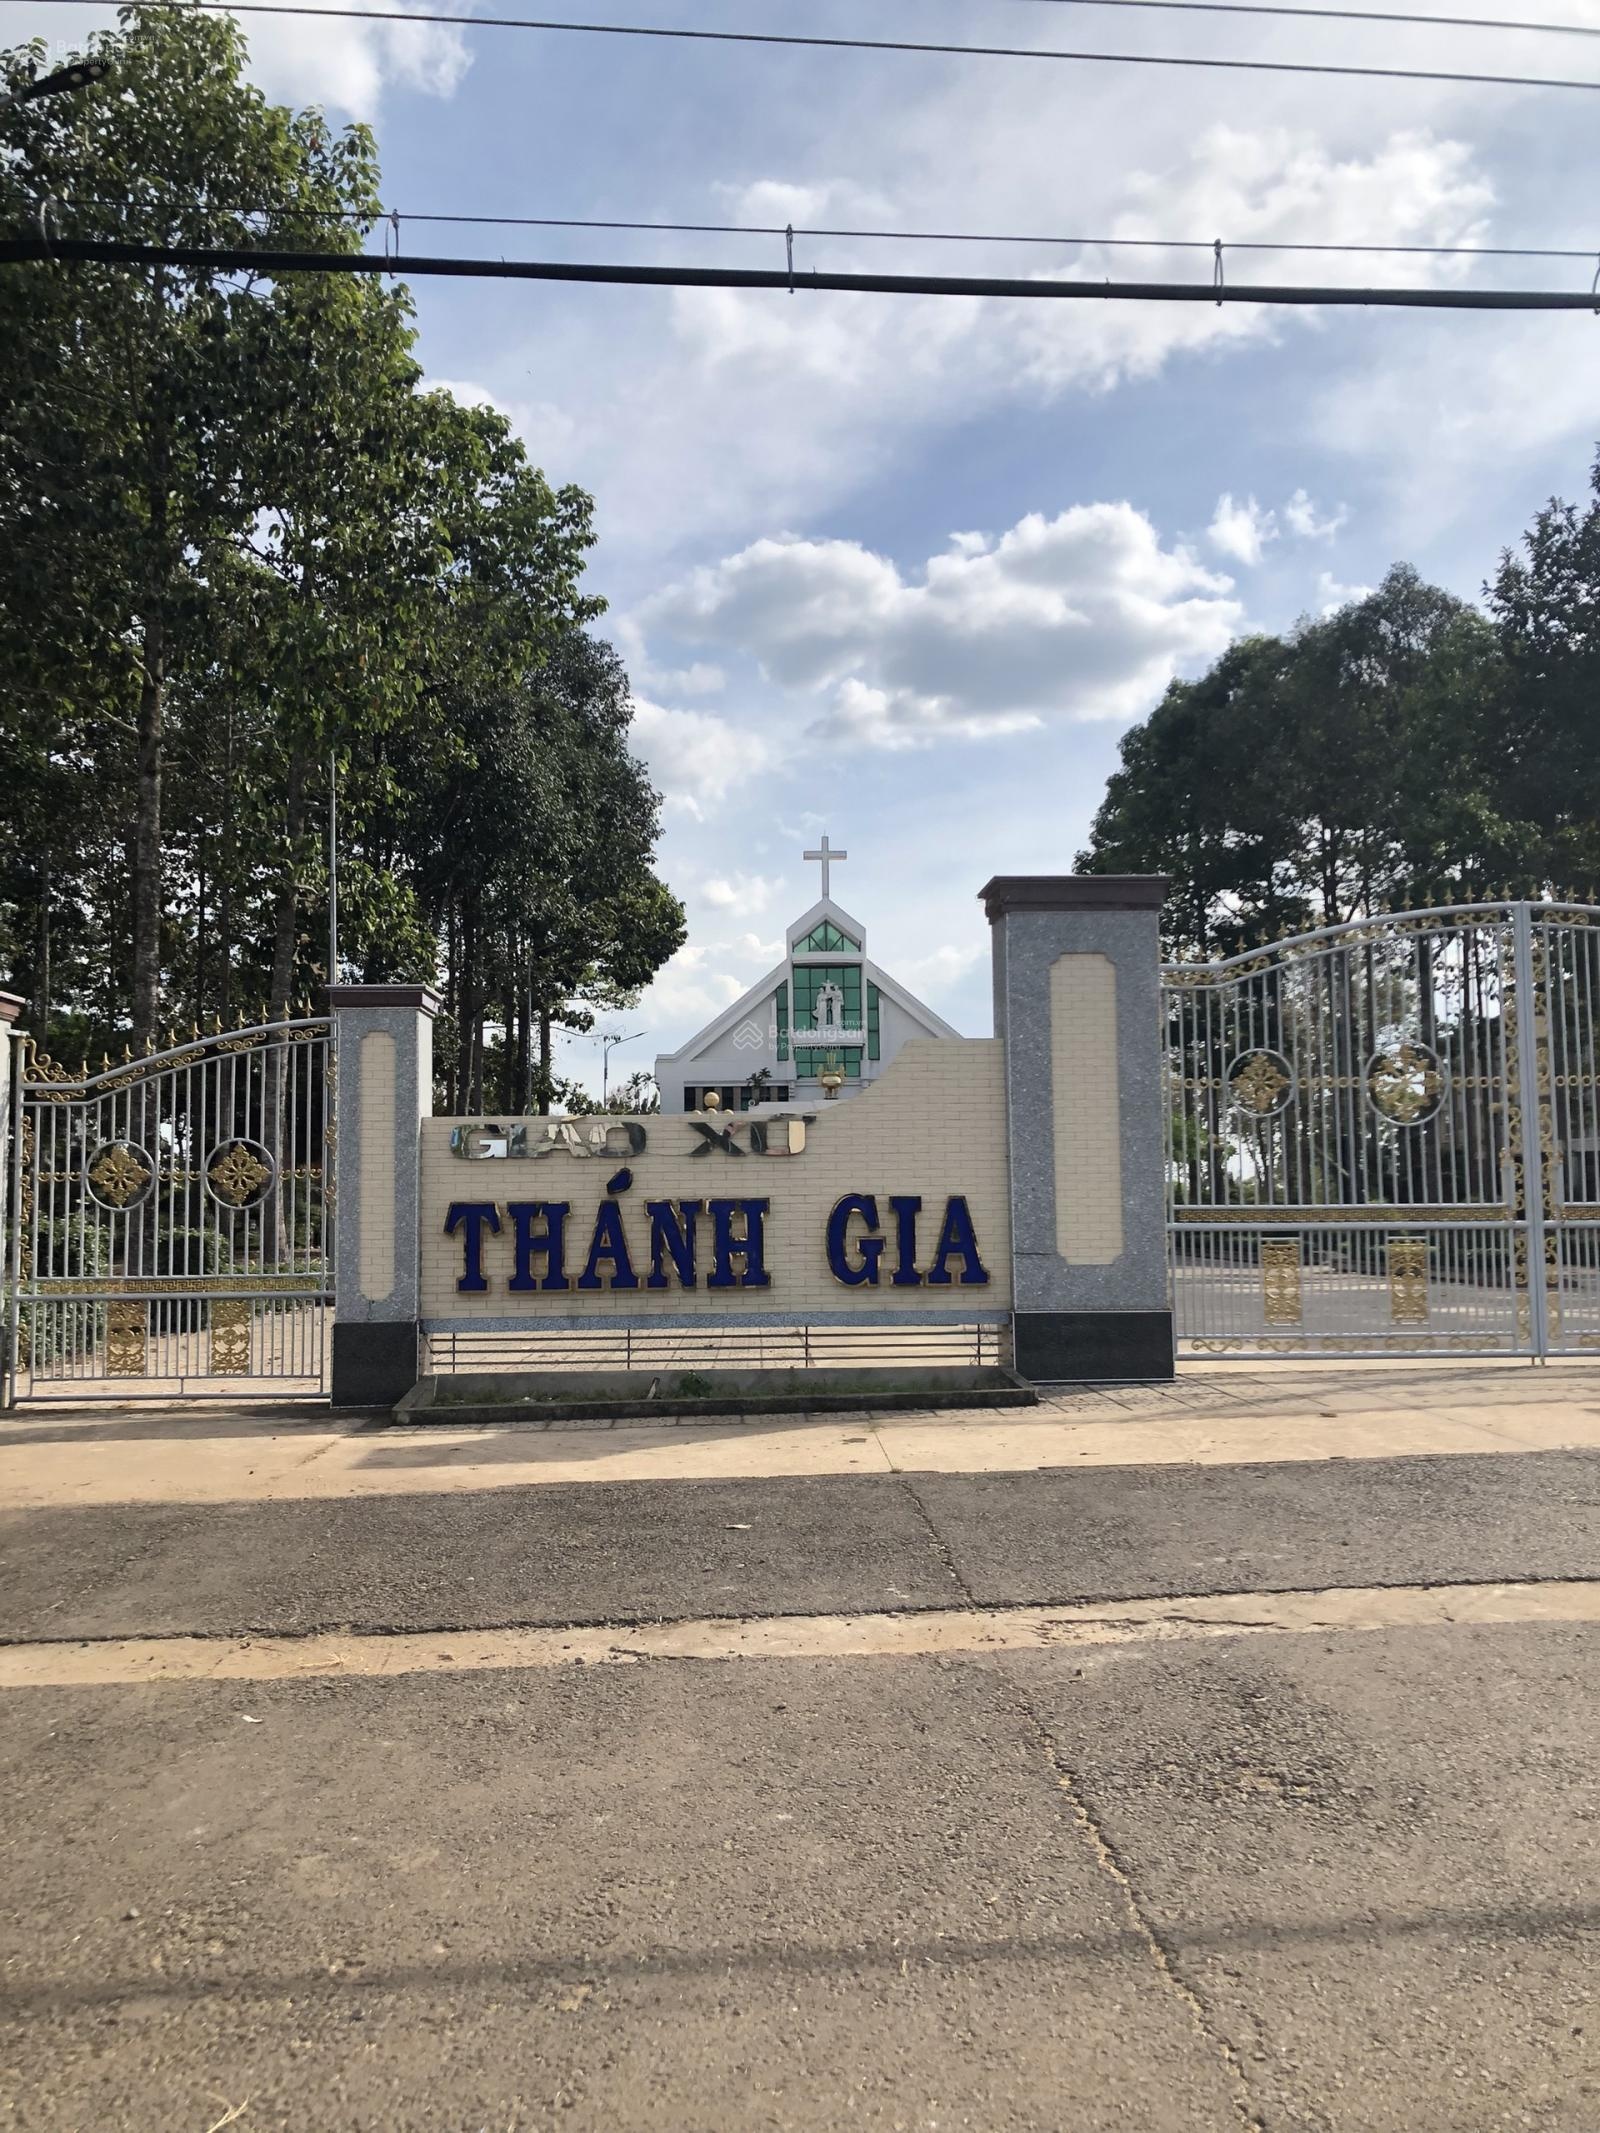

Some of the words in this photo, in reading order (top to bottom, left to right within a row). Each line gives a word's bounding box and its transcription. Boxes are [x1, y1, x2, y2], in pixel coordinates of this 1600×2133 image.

[450, 1115, 647, 1159] GIÁO
[442, 1167, 772, 1292] THÁNH
[825, 1193, 992, 1287] GIA
